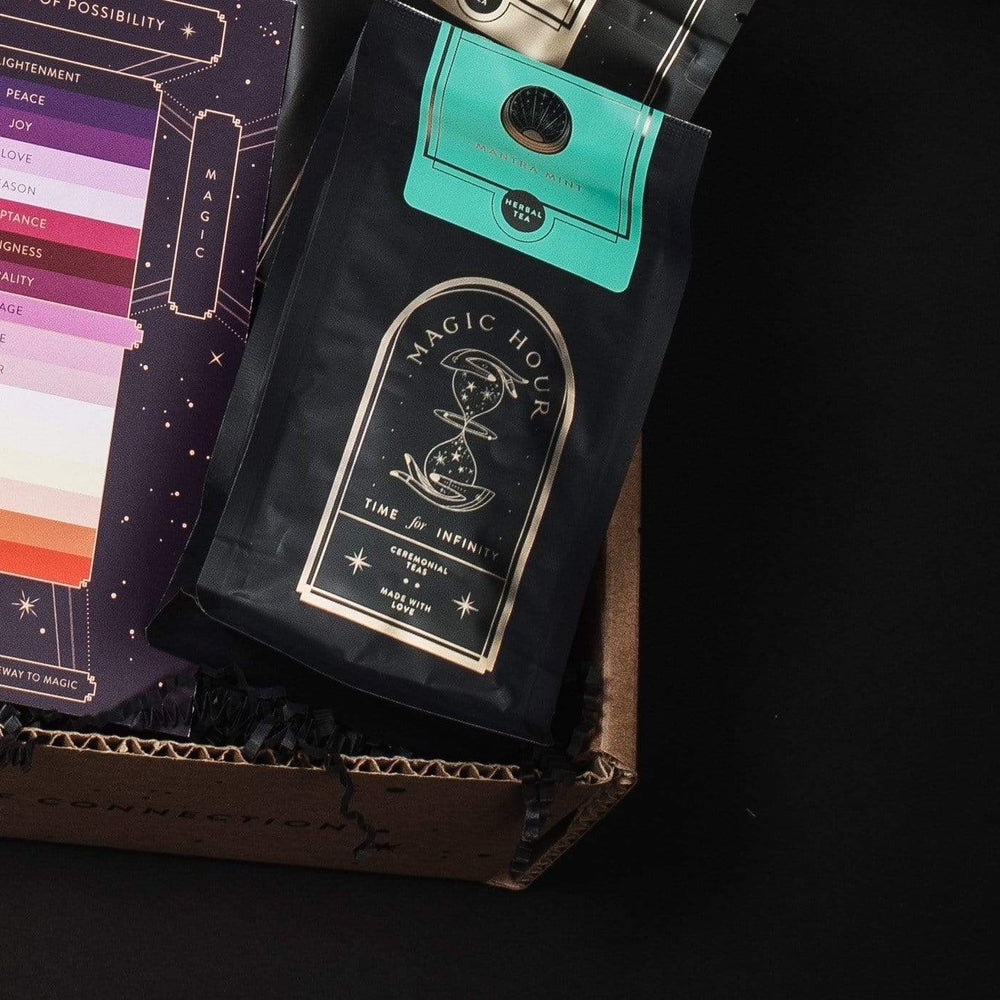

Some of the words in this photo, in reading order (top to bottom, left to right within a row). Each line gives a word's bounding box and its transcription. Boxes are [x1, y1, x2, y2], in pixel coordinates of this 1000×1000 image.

[68, 0, 165, 31] POSSIBILITY
[6, 88, 46, 106] PEACE
[8, 118, 33, 132] JOY
[1, 148, 33, 164] LOVE
[474, 142, 538, 174] MANTRA
[545, 170, 583, 192] MINT
[195, 168, 217, 259] MAGIC
[505, 198, 542, 219] HERBAL
[513, 210, 530, 223] TEA
[406, 312, 496, 366] MAGIC
[508, 329, 551, 419] HOUR
[364, 497, 399, 521] TIME
[405, 515, 428, 531] for
[436, 527, 500, 561] INFINITY
[390, 545, 449, 575] CEREMONIAL
[405, 561, 428, 576] TEAS
[380, 586, 406, 603] MADE
[410, 597, 432, 613] WITH
[391, 601, 416, 617] LOVE
[27, 671, 40, 683] TO
[42, 674, 79, 690] MAGIC
[36, 796, 347, 832] CONNECTION
